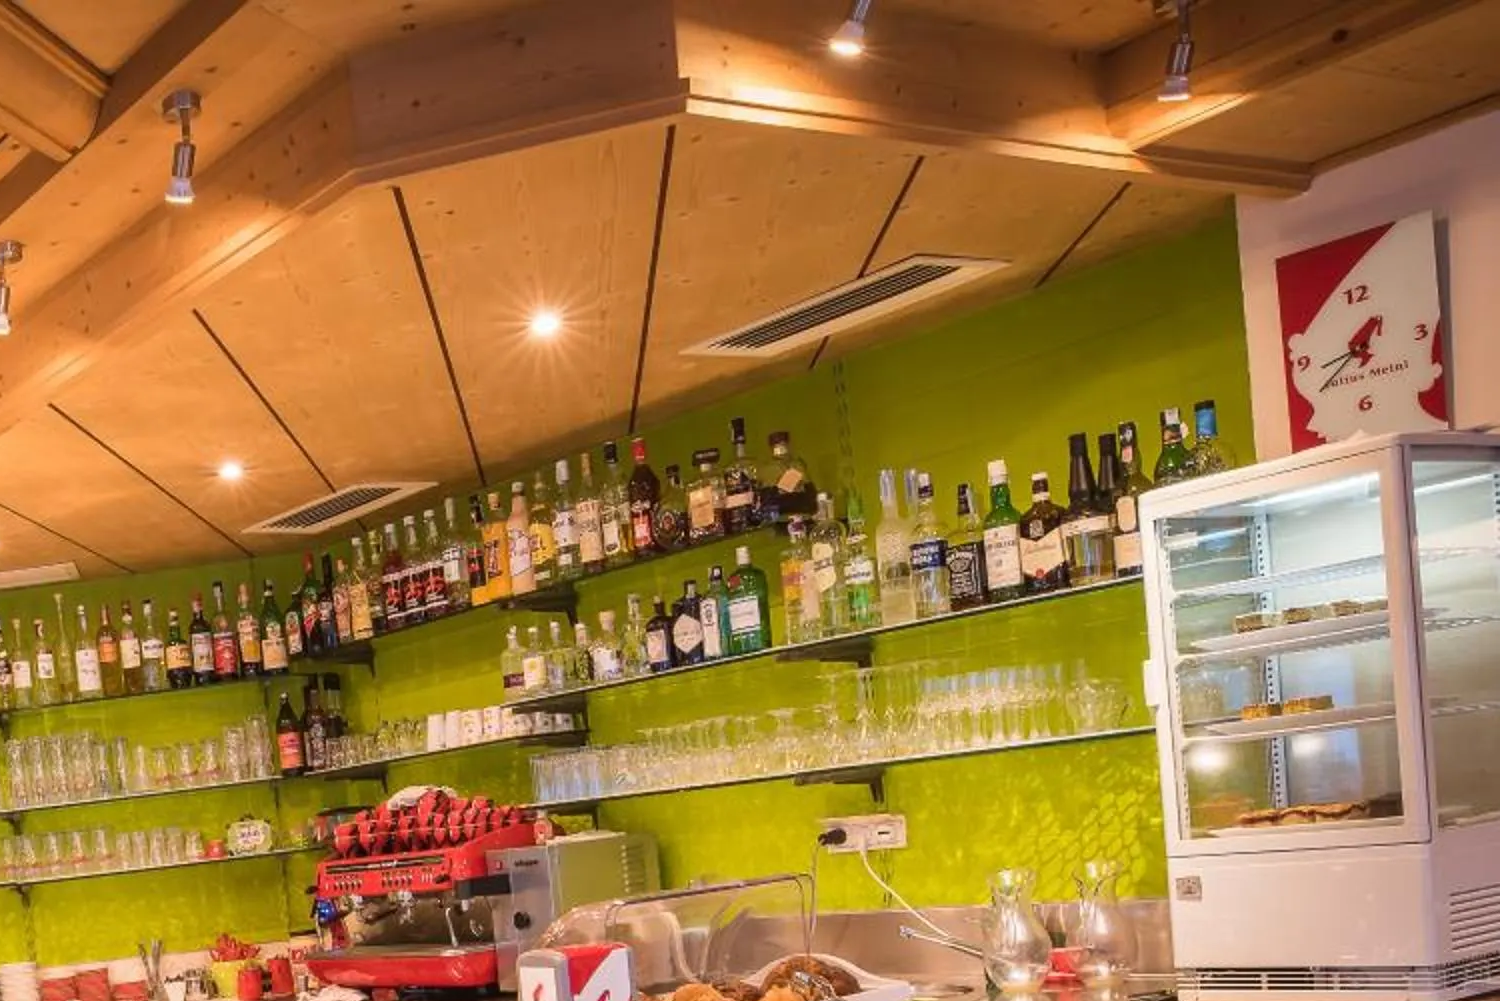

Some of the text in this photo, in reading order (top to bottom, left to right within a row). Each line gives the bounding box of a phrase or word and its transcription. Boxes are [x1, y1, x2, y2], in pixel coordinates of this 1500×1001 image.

[1343, 285, 1369, 304] 12
[1297, 324, 1428, 372] 9 3
[1358, 395, 1373, 411] 6
